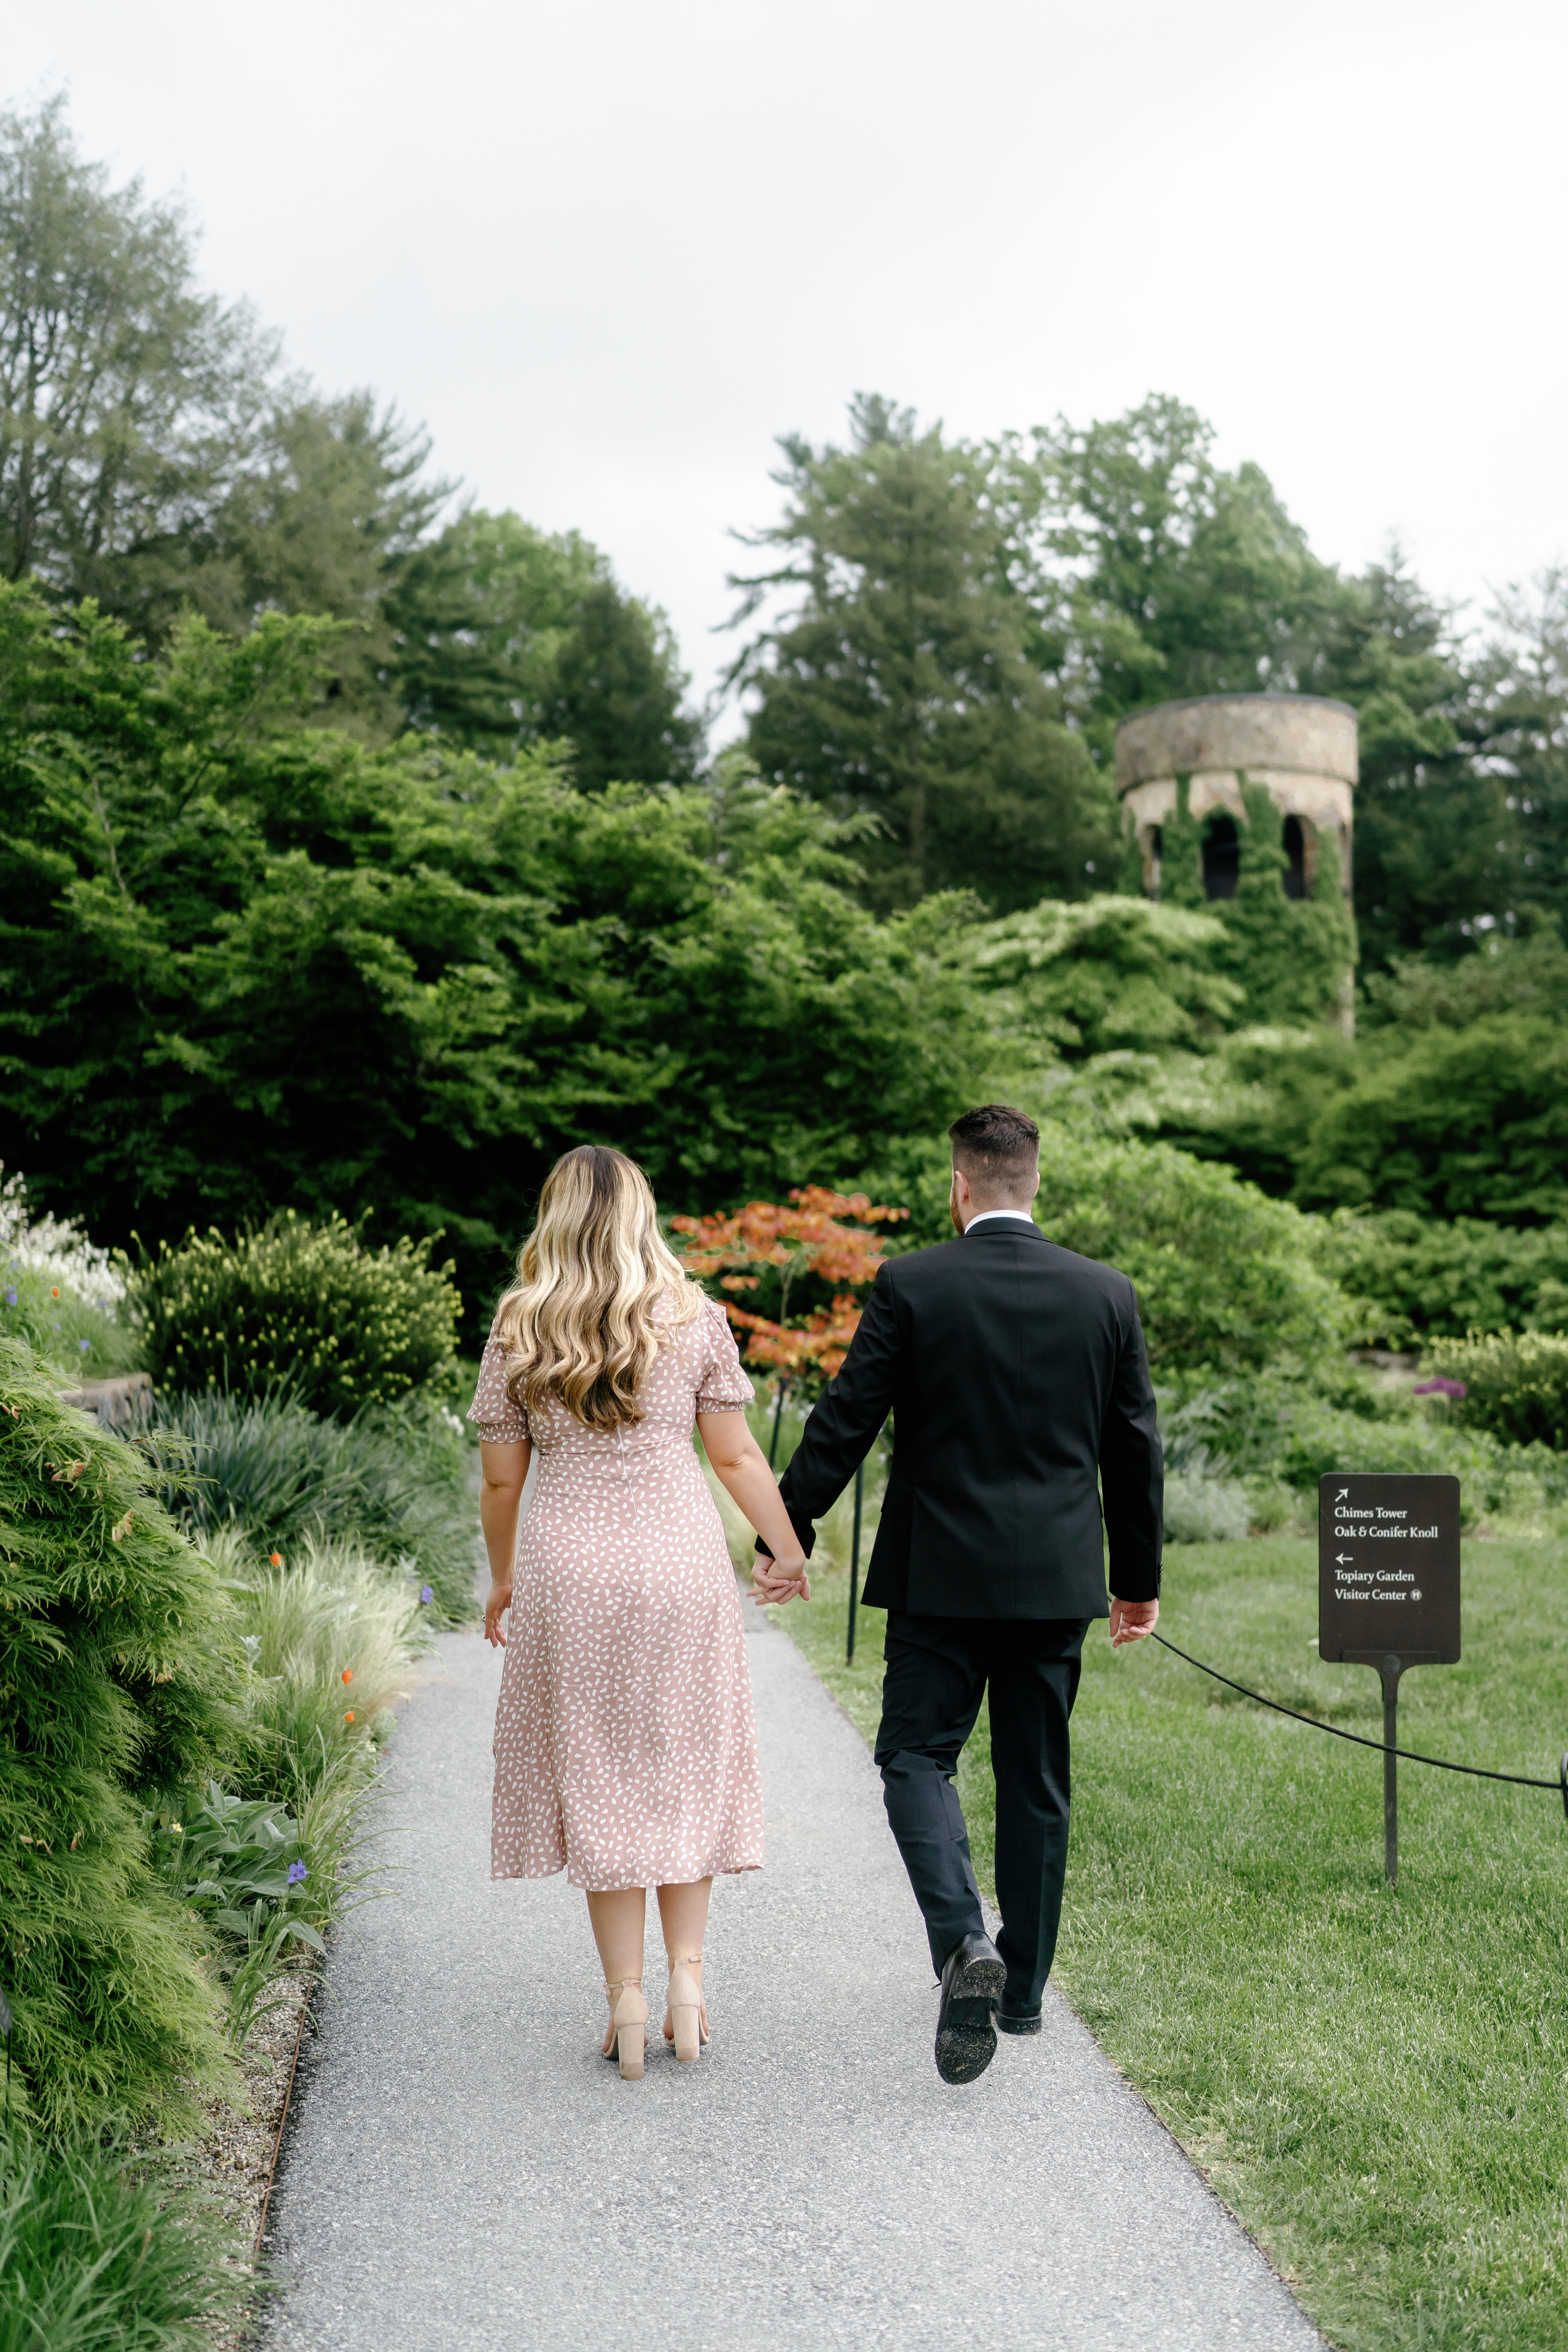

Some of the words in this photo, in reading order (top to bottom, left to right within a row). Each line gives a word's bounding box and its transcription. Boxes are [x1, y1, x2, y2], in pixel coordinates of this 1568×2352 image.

[1335, 1506, 1374, 1518] Chimes
[1376, 1507, 1407, 1518] Tower
[1335, 1525, 1356, 1537] Oak
[1358, 1526, 1367, 1537] &
[1369, 1526, 1408, 1537] Conifer
[1410, 1526, 1437, 1537] Knoll
[1335, 1570, 1374, 1584] Topiary
[1376, 1570, 1414, 1581] Garden
[1335, 1589, 1370, 1599] Visitor
[1372, 1589, 1406, 1600] Center
